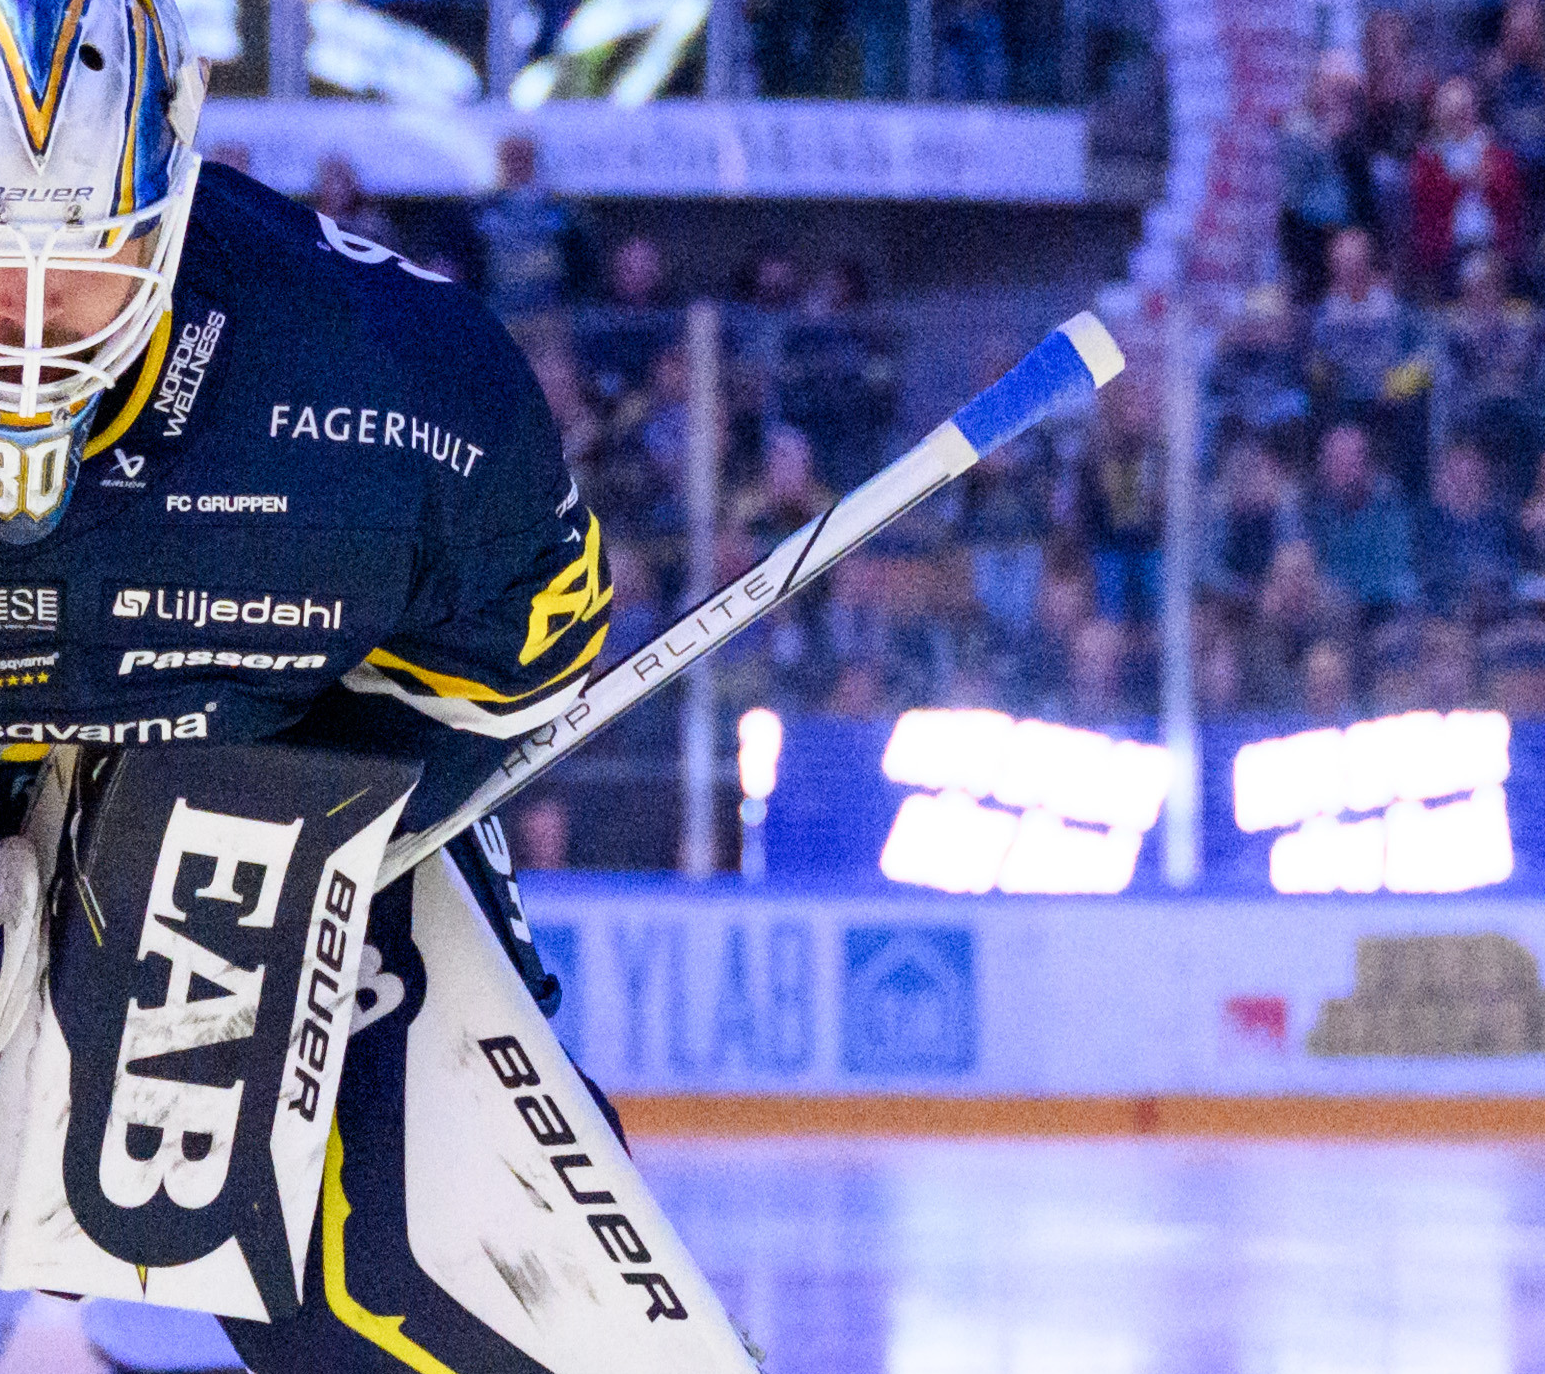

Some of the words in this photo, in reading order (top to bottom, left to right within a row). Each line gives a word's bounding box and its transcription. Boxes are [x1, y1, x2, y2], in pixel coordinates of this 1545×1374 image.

[154, 323, 201, 414] NORDIC
[164, 311, 226, 438] WELLNESS
[269, 405, 485, 478] FAGERHULT
[166, 496, 192, 513] FC
[197, 496, 288, 513] GRUPPEN
[157, 589, 342, 630] Liljedahl
[99, 797, 305, 1211] EAB
[285, 869, 357, 1123] BAUER
[477, 1033, 691, 1325] BAUER
